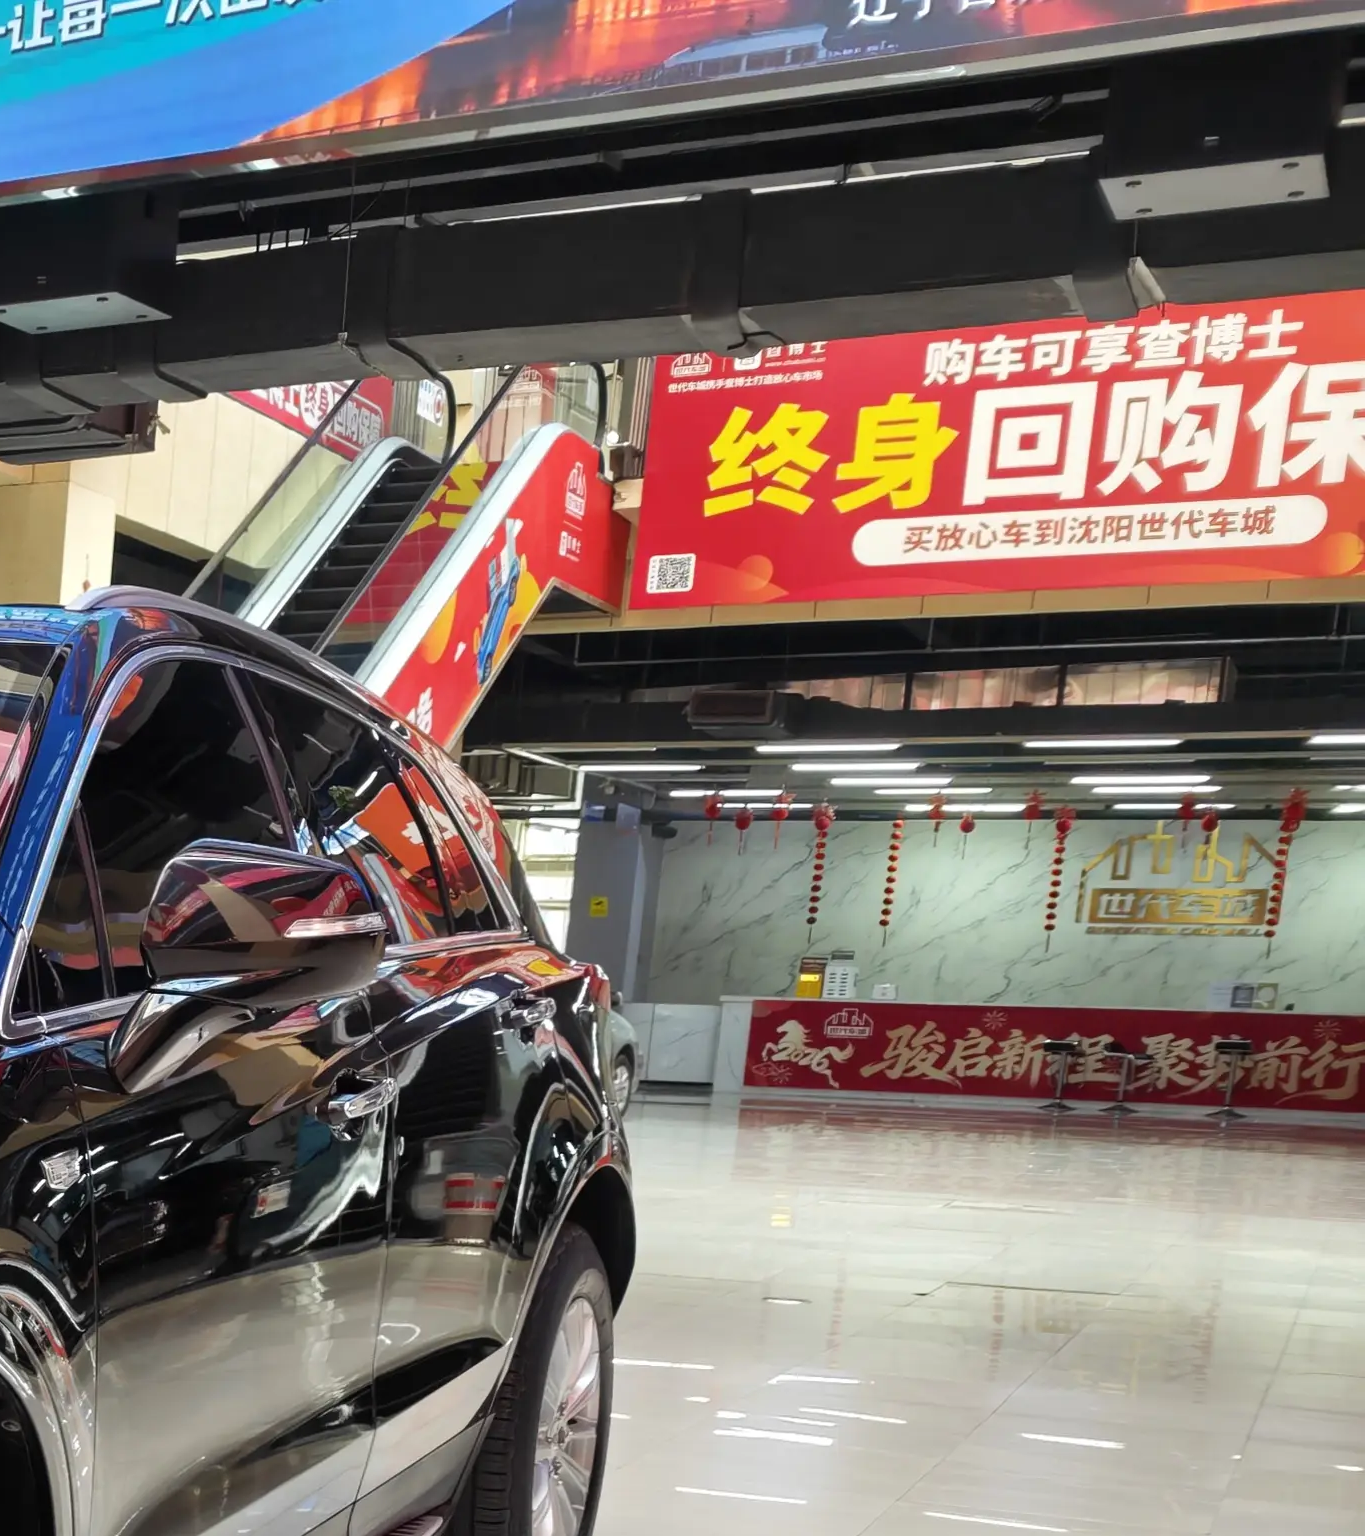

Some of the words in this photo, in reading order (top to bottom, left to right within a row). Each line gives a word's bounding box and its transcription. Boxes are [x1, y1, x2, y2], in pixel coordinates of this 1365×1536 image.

[923, 309, 1305, 386] 购车可享查博士
[901, 505, 1278, 555] 买放心车到沈阳世代车城
[1098, 892, 1259, 919] 世代车城
[772, 1041, 829, 1071] 2026
